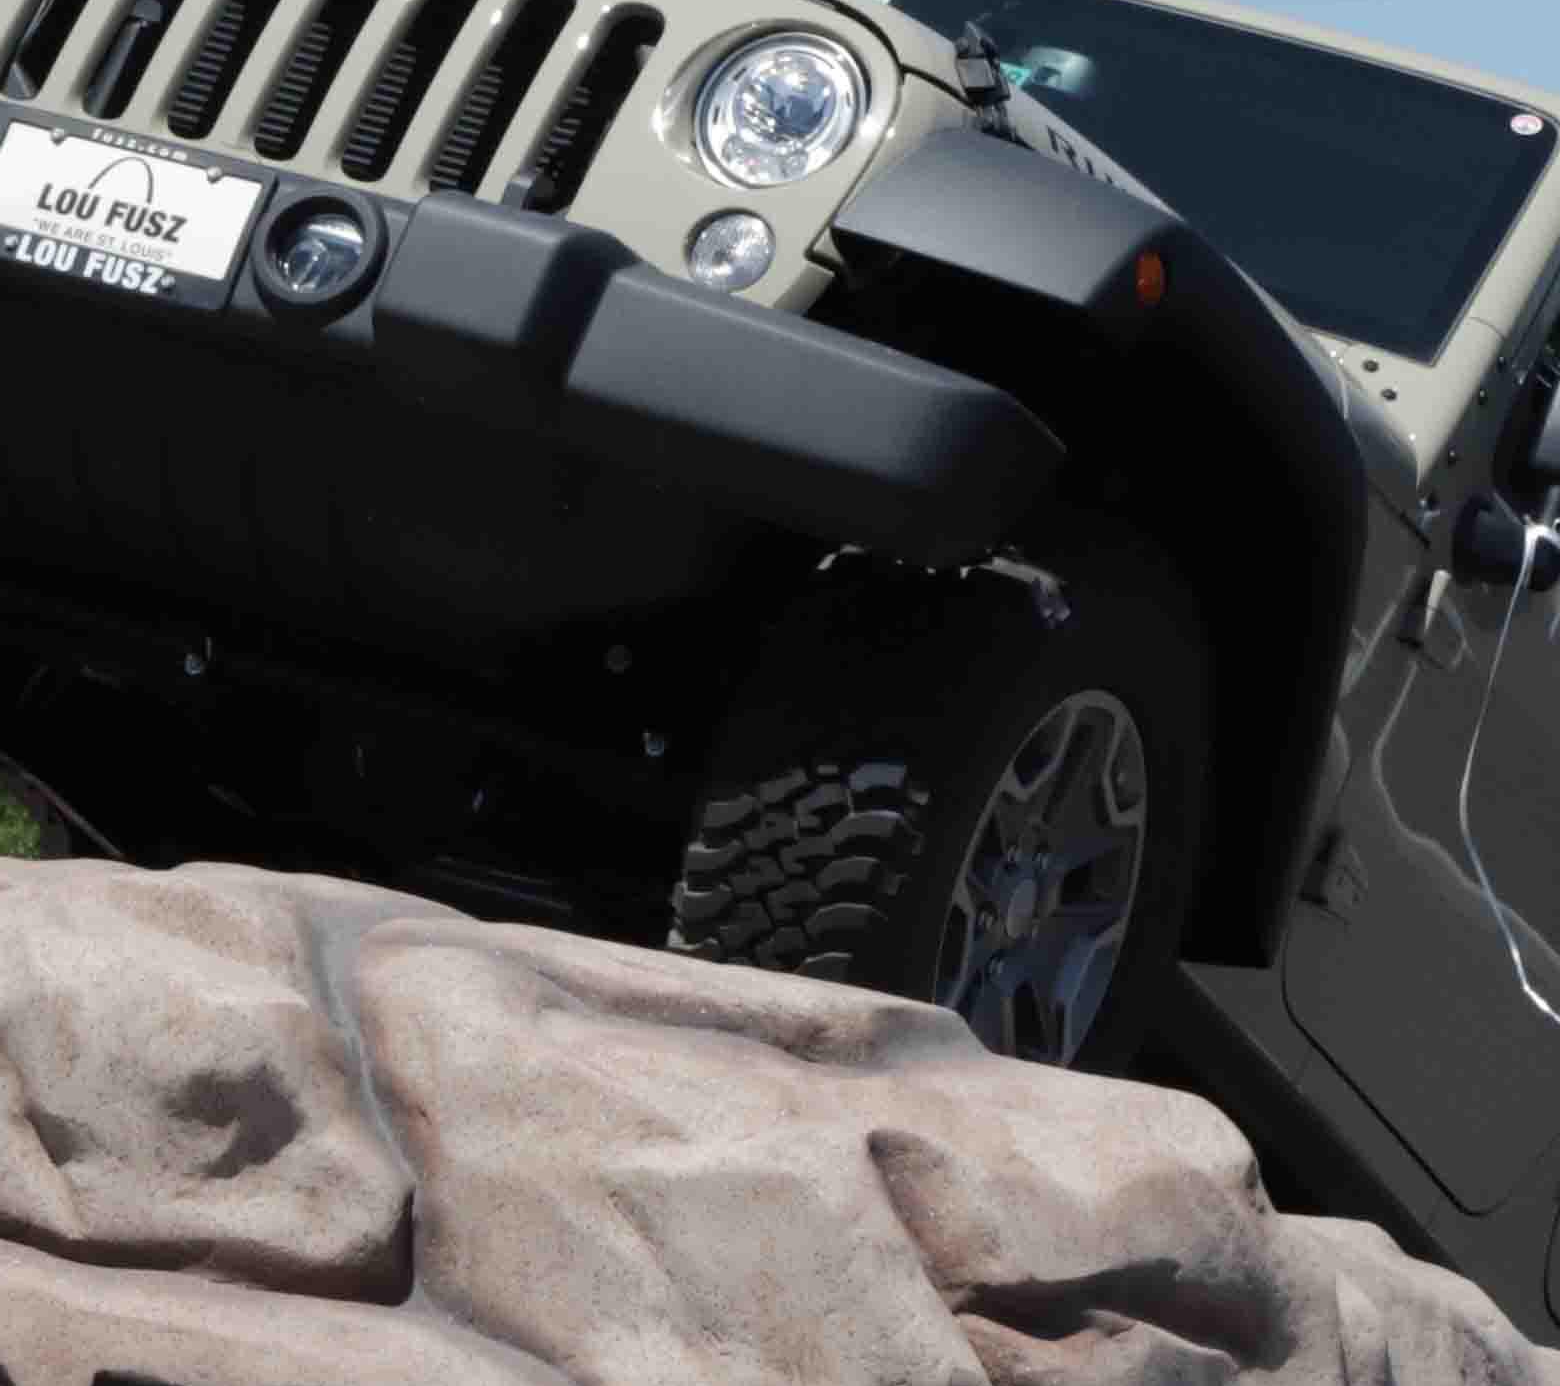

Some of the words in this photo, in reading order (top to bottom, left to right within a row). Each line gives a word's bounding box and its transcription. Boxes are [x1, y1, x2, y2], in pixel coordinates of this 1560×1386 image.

[37, 183, 101, 219] LOU
[105, 201, 188, 243] FUSZ
[16, 234, 78, 272] LOU
[83, 252, 165, 294] FUSZ
